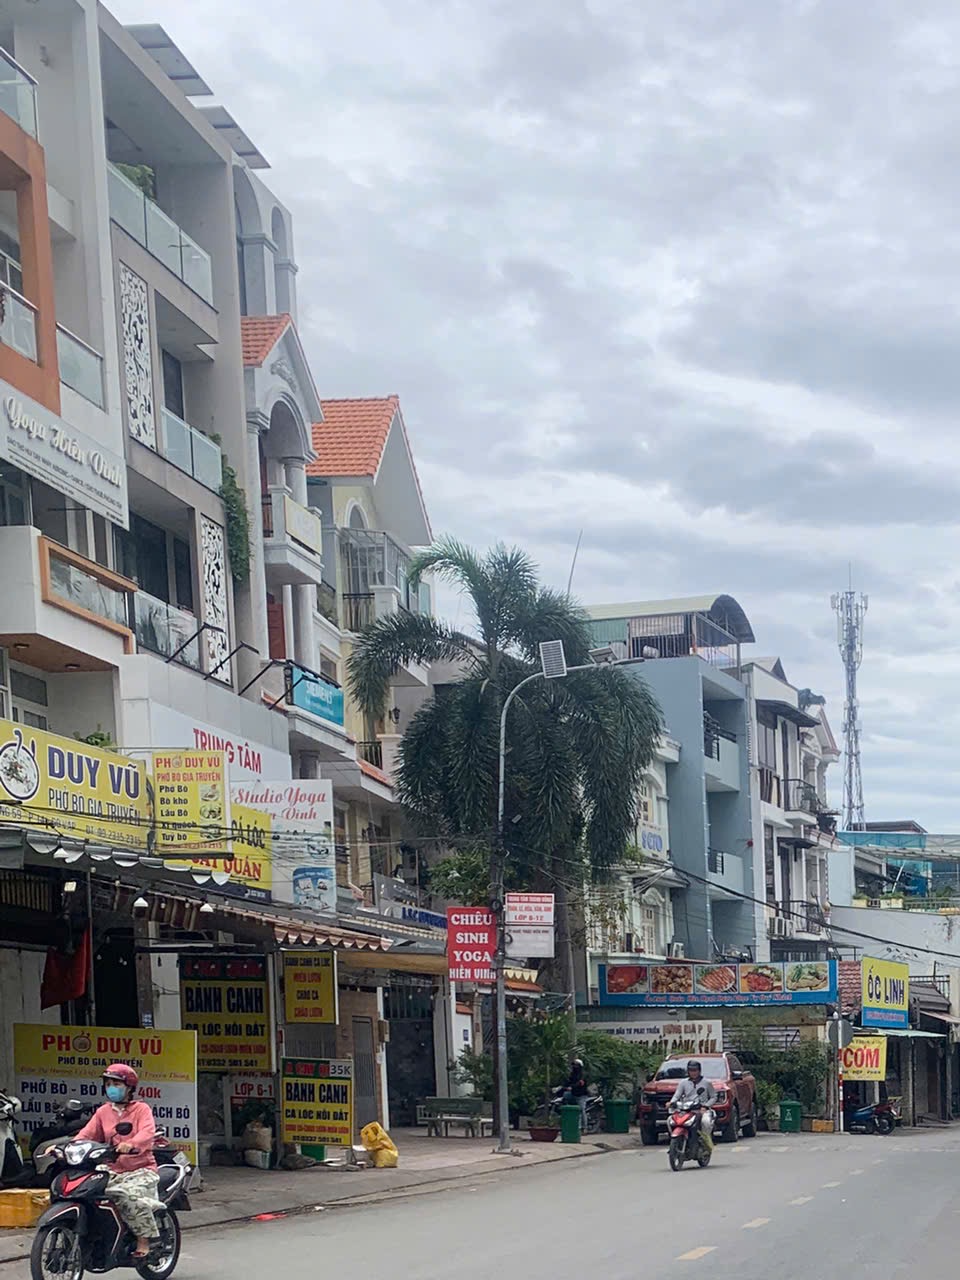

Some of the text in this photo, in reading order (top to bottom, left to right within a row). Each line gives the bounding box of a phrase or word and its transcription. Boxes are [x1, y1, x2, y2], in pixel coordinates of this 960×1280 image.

[185, 758, 204, 768] DUY
[238, 742, 262, 774] TÂM
[48, 745, 140, 799] DUY VŨ
[48, 786, 69, 811] PHỞ
[88, 797, 103, 818] GIA
[173, 797, 188, 805] kho
[234, 787, 327, 806] Studio Yoga
[451, 911, 492, 926] CHIÊU
[456, 932, 488, 944] SINH
[453, 951, 492, 962] YOGA
[868, 965, 905, 1005] ỐC LINH
[185, 982, 264, 1013] BÁNH CANH
[97, 1037, 134, 1054] DUY
[139, 1035, 163, 1055] VŨ
[93, 1057, 107, 1066] GIA
[843, 1045, 880, 1068] CƠM
[330, 1064, 351, 1075] 35K
[21, 1078, 47, 1094] PHỞ
[51, 1080, 67, 1094] BÒ
[80, 1082, 97, 1096] BÒ
[138, 1086, 161, 1098] 40k
[234, 1081, 254, 1096] LỚP
[285, 1079, 348, 1104] BÁNH CANH
[21, 1099, 42, 1113] LẨU
[178, 1106, 190, 1119] BÒ
[173, 1125, 190, 1138] BÒ
